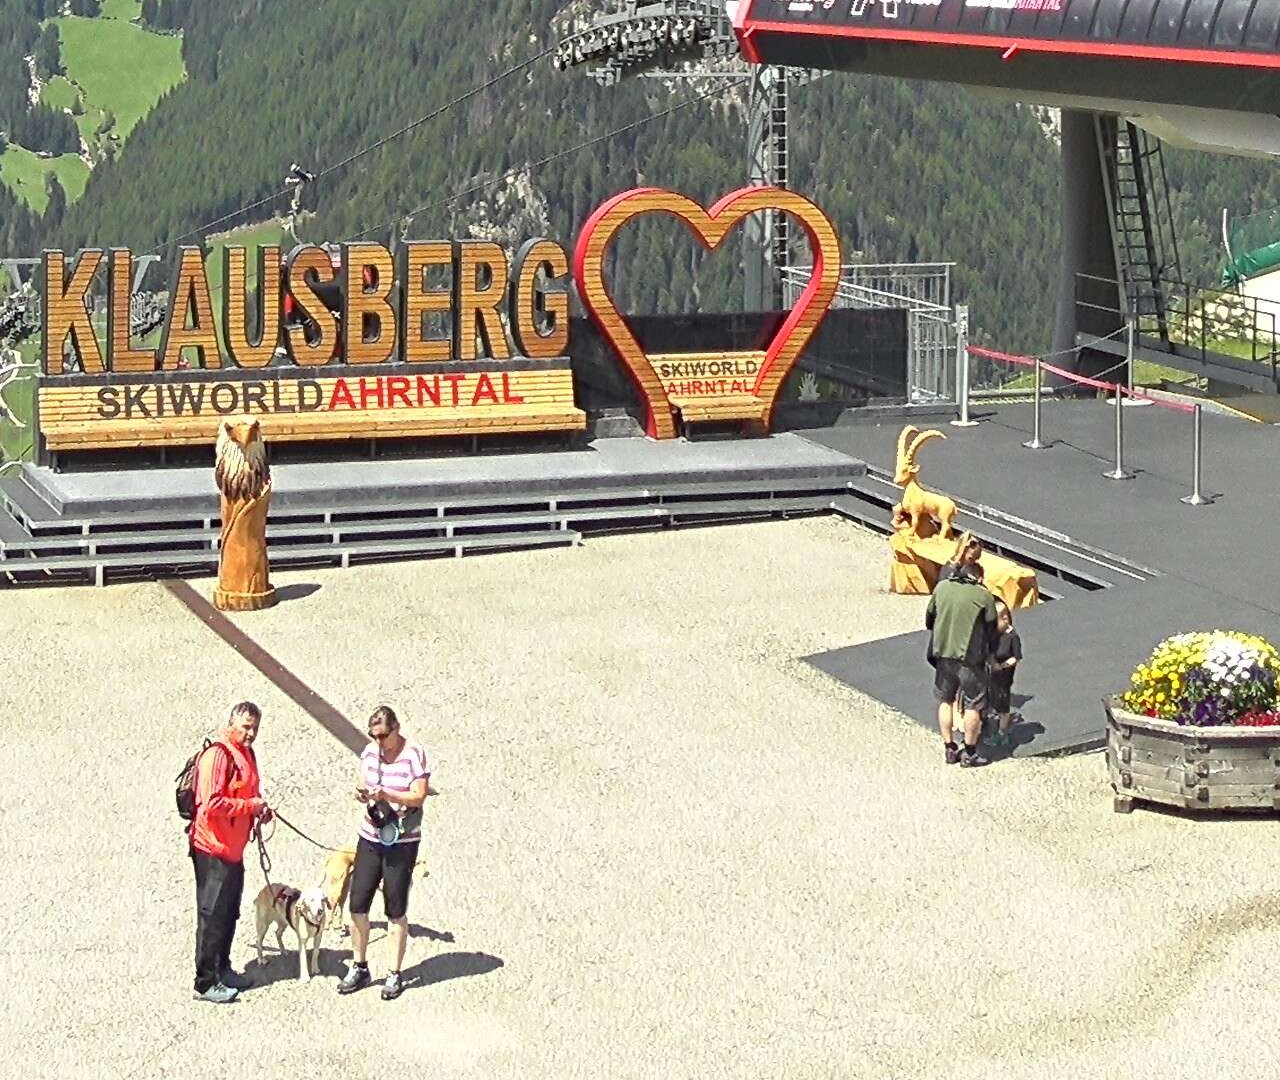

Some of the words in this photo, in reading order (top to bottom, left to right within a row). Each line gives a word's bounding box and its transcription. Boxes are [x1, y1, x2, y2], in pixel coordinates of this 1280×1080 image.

[42, 238, 569, 376] KLAUSBERG
[660, 360, 758, 378] SKIWORLD
[668, 379, 756, 395] AHRNTAL
